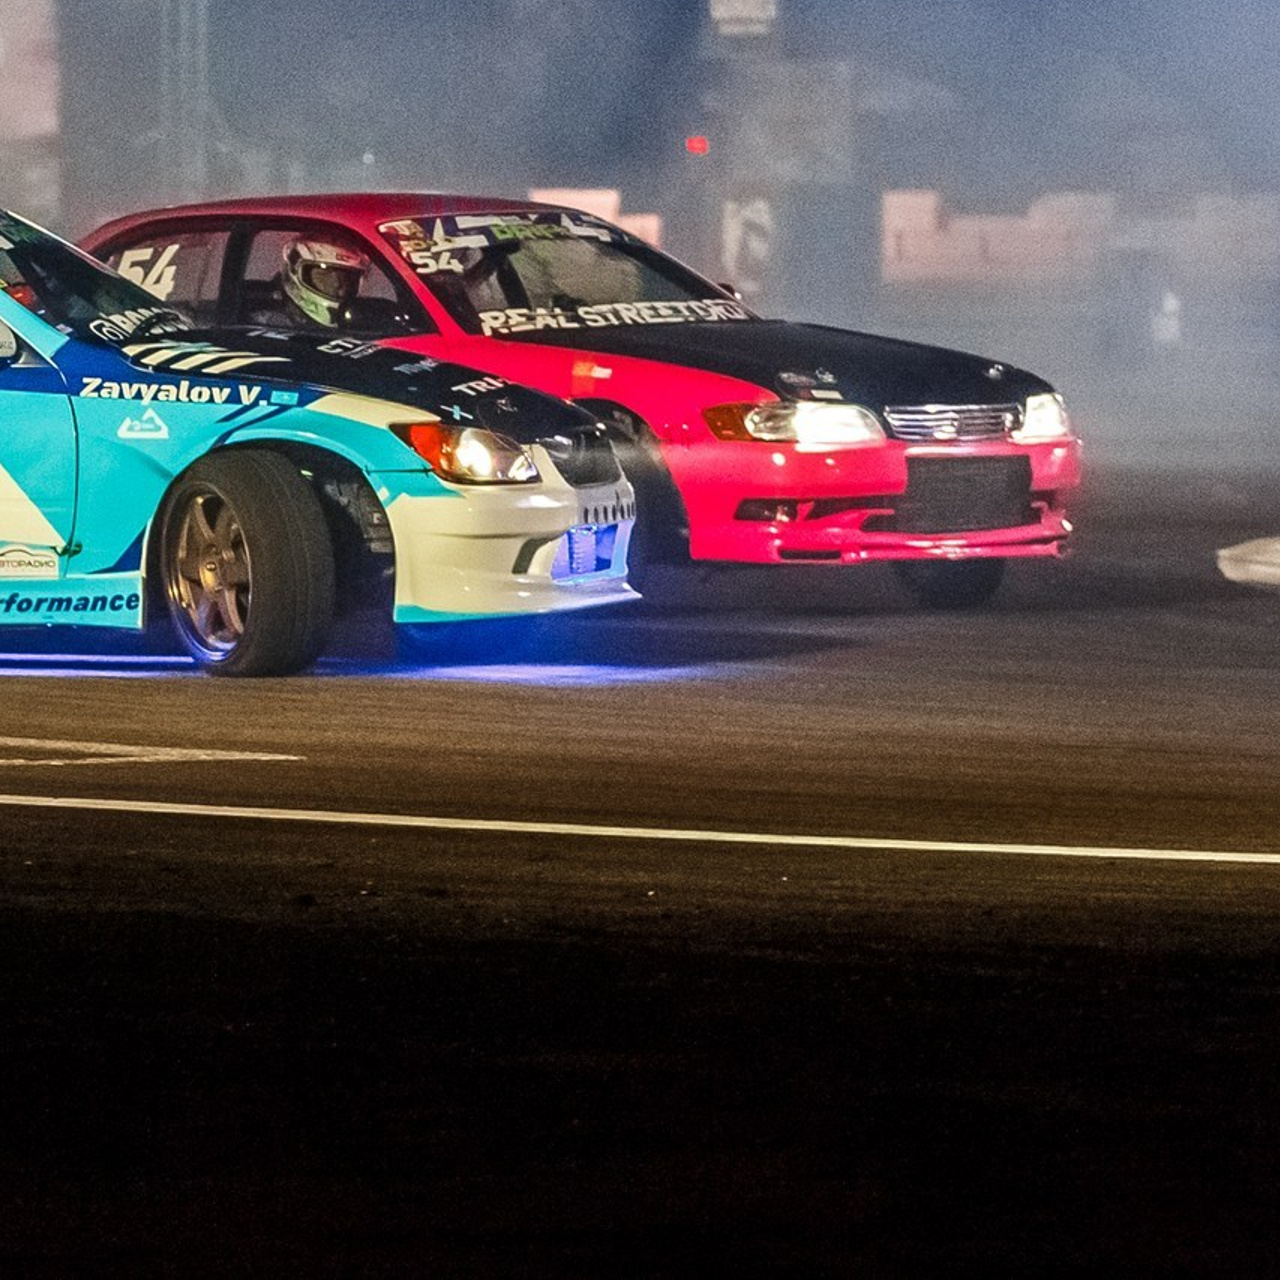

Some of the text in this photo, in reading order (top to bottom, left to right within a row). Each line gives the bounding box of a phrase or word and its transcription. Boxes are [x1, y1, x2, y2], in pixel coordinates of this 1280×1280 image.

[117, 243, 180, 302] 54
[408, 251, 465, 275] 54
[478, 307, 581, 337] REAL
[79, 376, 268, 407] Zavyalov V.
